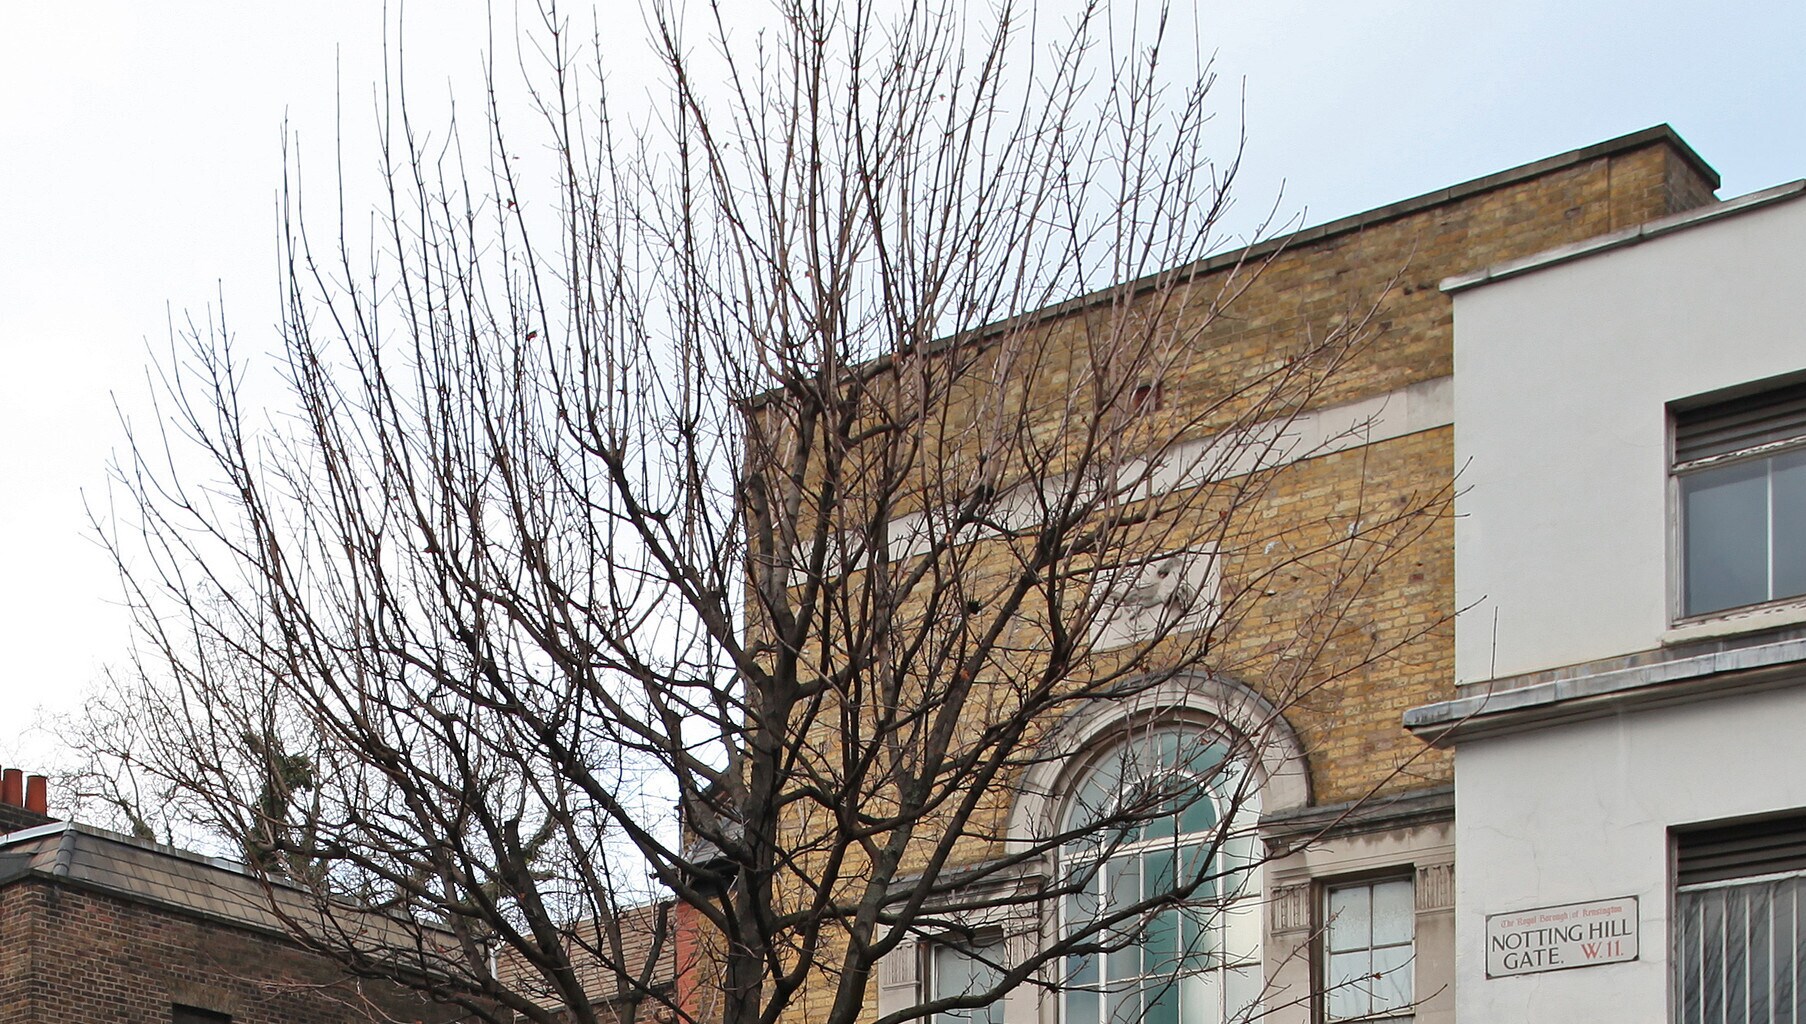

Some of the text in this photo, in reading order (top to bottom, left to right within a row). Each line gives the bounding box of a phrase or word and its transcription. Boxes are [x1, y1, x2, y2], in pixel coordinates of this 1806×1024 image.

[1517, 915, 1537, 927] Royal
[1540, 911, 1569, 923] Borough
[1572, 910, 1579, 920] of
[1582, 905, 1623, 917] Kensington
[1492, 919, 1632, 952] NOTTING HILL
[1503, 947, 1564, 970] GATE.
